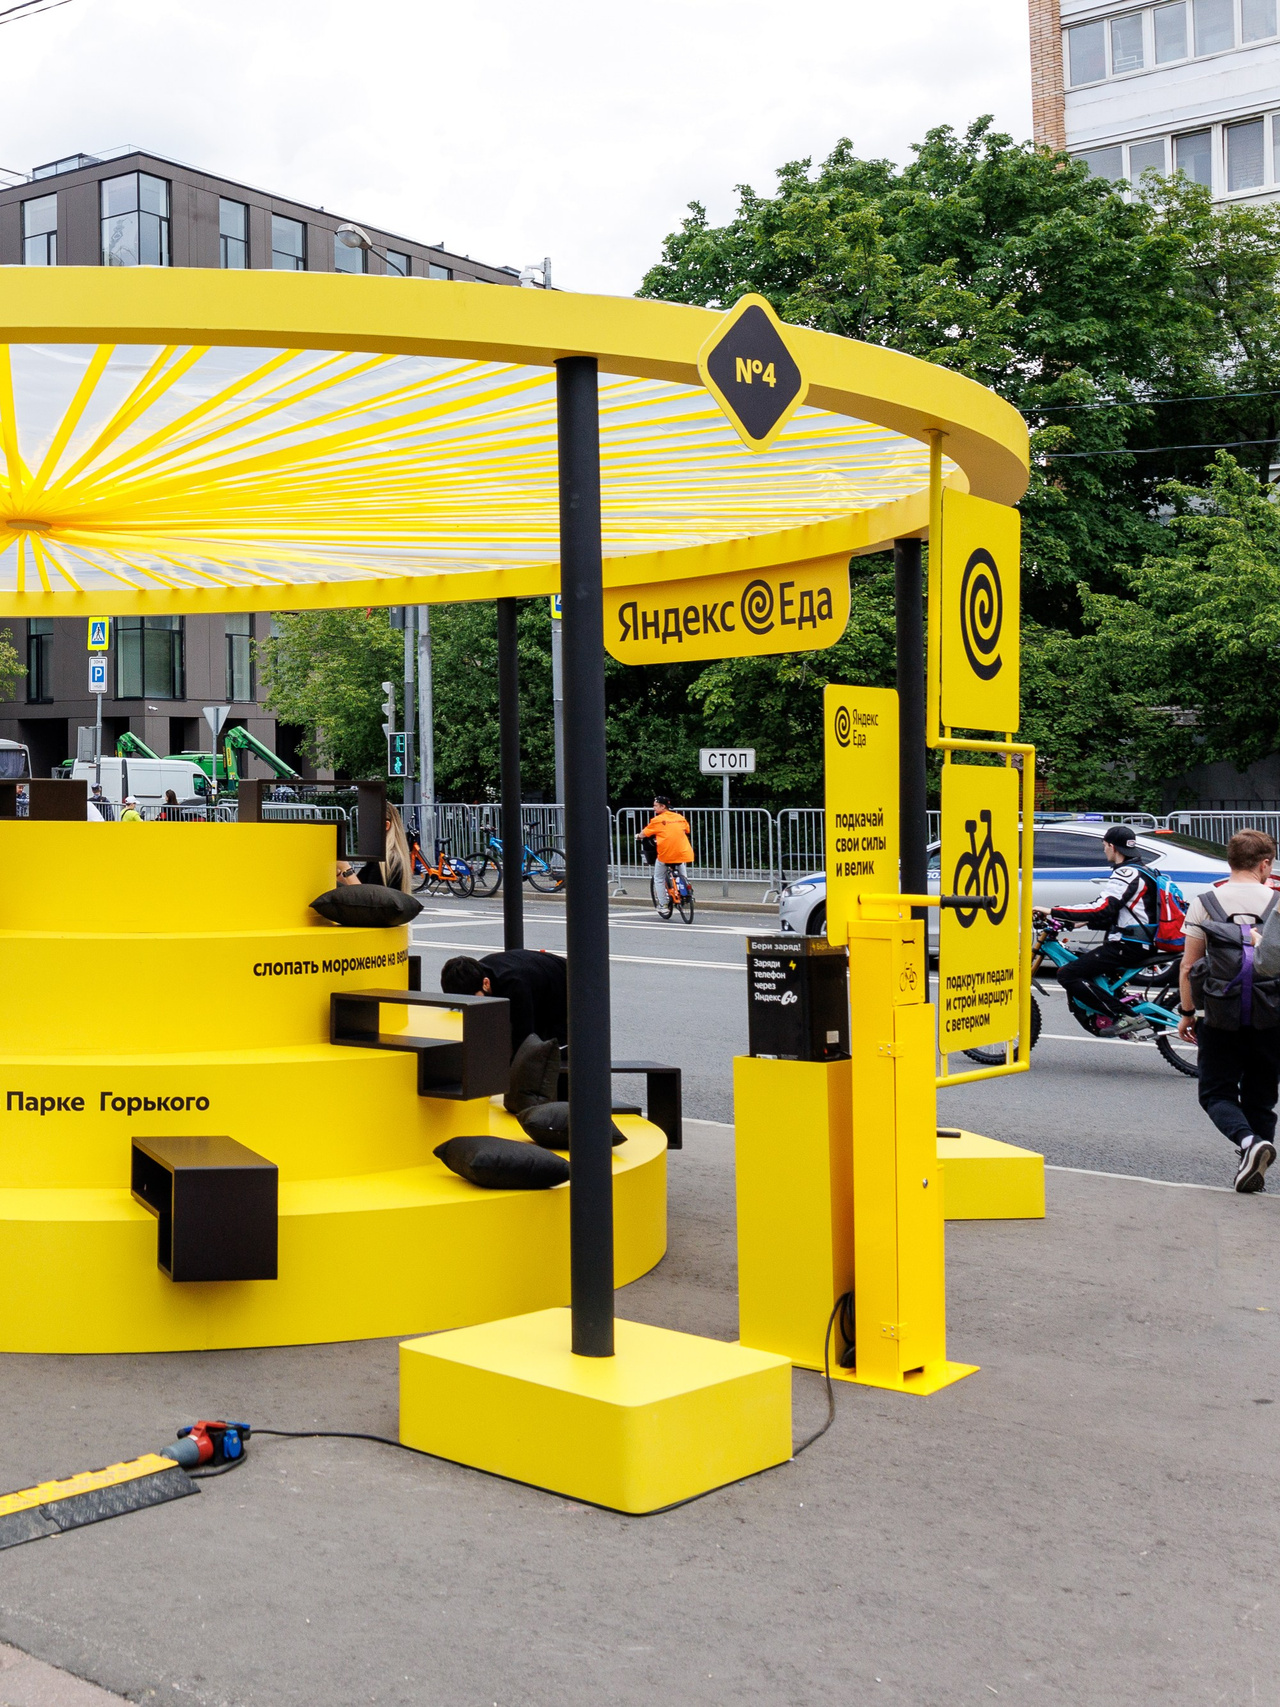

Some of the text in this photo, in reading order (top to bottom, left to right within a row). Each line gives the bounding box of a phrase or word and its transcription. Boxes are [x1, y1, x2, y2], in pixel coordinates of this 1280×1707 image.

[735, 356, 777, 388] №4
[618, 580, 833, 644] Яндекс Еда
[852, 709, 879, 728] Яндекс
[852, 729, 867, 748] Еда
[708, 753, 748, 768] СТОП
[835, 807, 884, 831] подкачай
[835, 836, 887, 853] свои силы
[836, 860, 875, 877] и велик
[751, 941, 802, 952] Бери заряд!
[253, 960, 319, 977] слопать
[322, 953, 387, 976] мороженое
[387, 952, 396, 966] на
[753, 958, 781, 969] Заряди
[753, 970, 787, 980] телефон
[946, 968, 1014, 991] подкрути педали
[754, 982, 777, 991] через
[754, 990, 798, 1006] Яндекс Go
[946, 988, 1014, 1013] и строй маршрут
[945, 1012, 991, 1033] с ветерком
[6, 1090, 86, 1116] Парке
[99, 1090, 211, 1116] Горького
